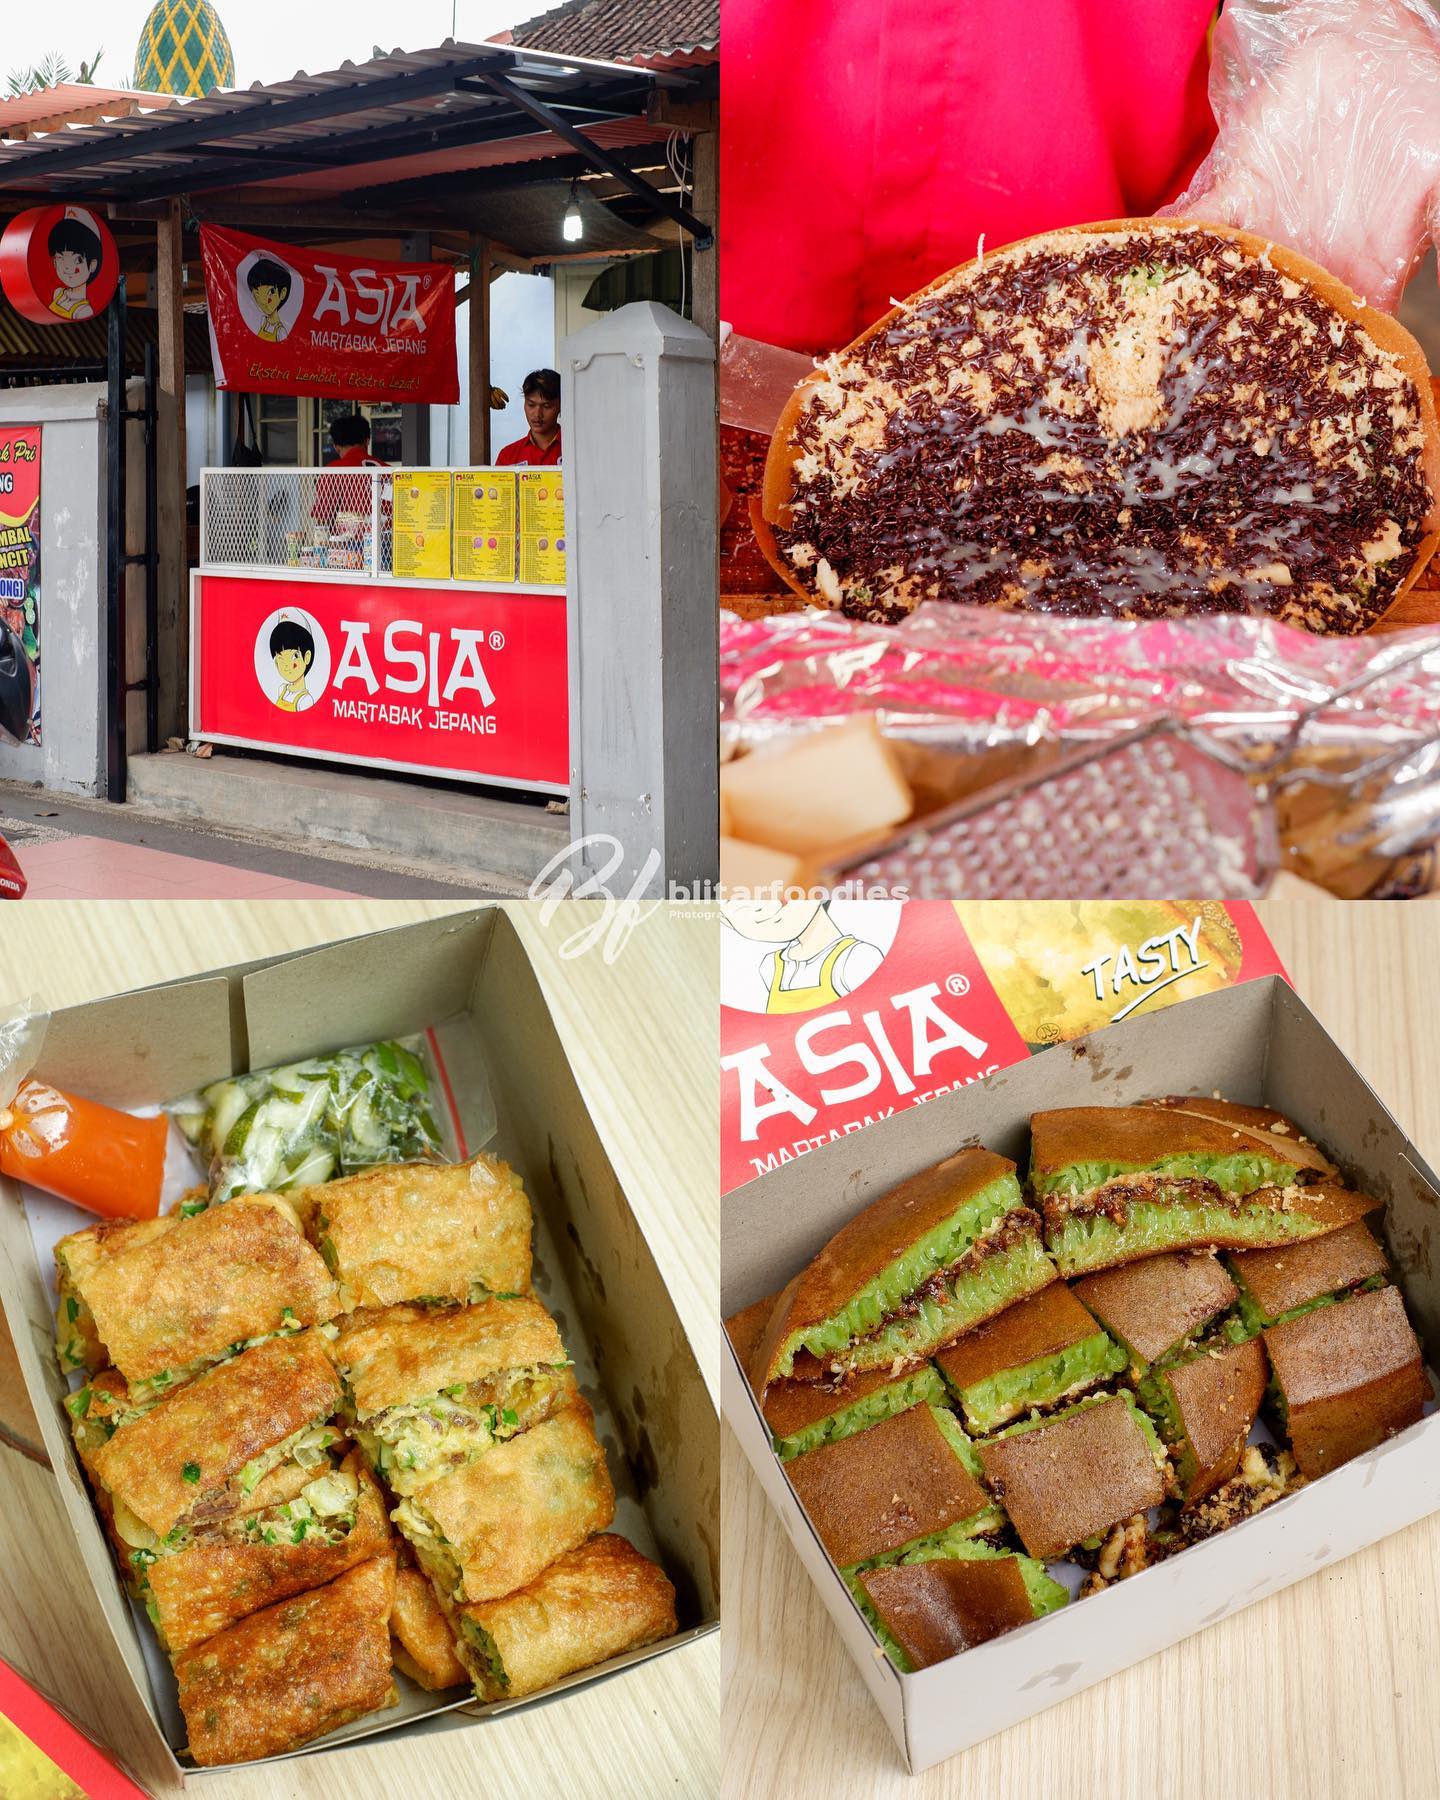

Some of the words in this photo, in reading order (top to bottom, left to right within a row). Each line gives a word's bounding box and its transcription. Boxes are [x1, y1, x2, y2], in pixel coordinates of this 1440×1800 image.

[313, 264, 427, 336] ASIA
[248, 362, 290, 381] Ekstra
[348, 371, 385, 389] Ekstra
[310, 330, 377, 353] MARTABAK
[382, 337, 427, 355] JEPANG
[332, 619, 497, 708] ASIA
[332, 699, 423, 730] MARTABAK
[428, 710, 497, 735] JEPANG
[1081, 915, 1202, 1001] TASTY
[720, 981, 989, 1142] ASIA
